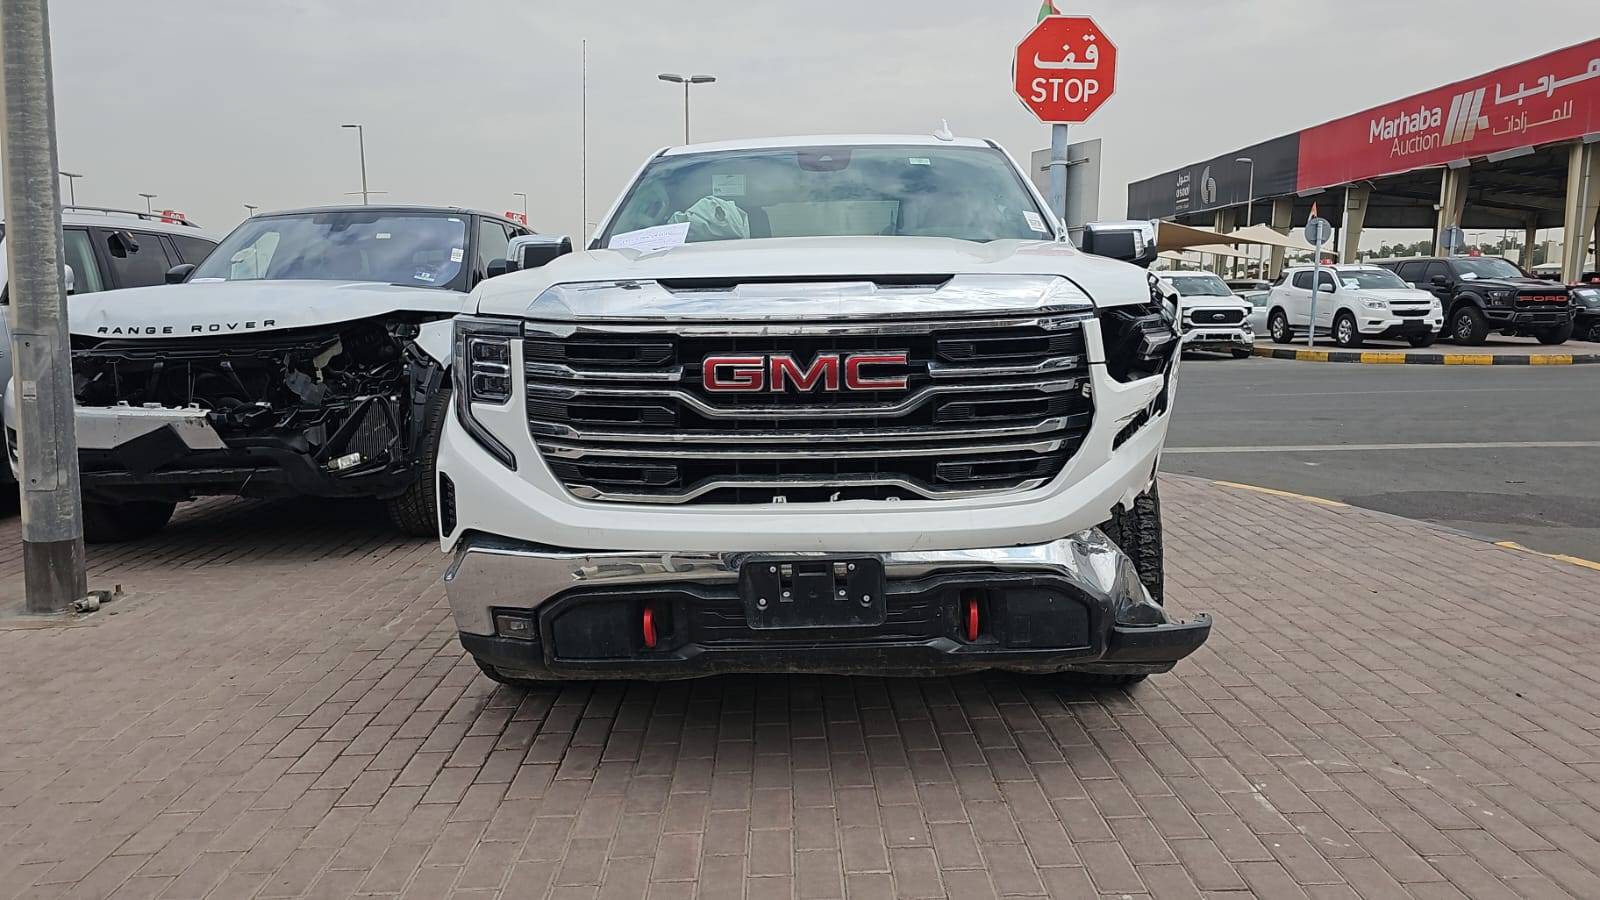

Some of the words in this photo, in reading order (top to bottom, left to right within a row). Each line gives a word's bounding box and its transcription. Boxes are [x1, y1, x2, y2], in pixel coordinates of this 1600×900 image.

[1033, 33, 1099, 70] قف
[1030, 77, 1099, 103] STOP
[1369, 105, 1442, 144] Marhaba
[1492, 99, 1573, 136] للمزادات
[1390, 131, 1440, 158] Auction
[97, 326, 173, 335] RANGE
[191, 319, 276, 333] ROVER
[702, 353, 909, 392] GMC
